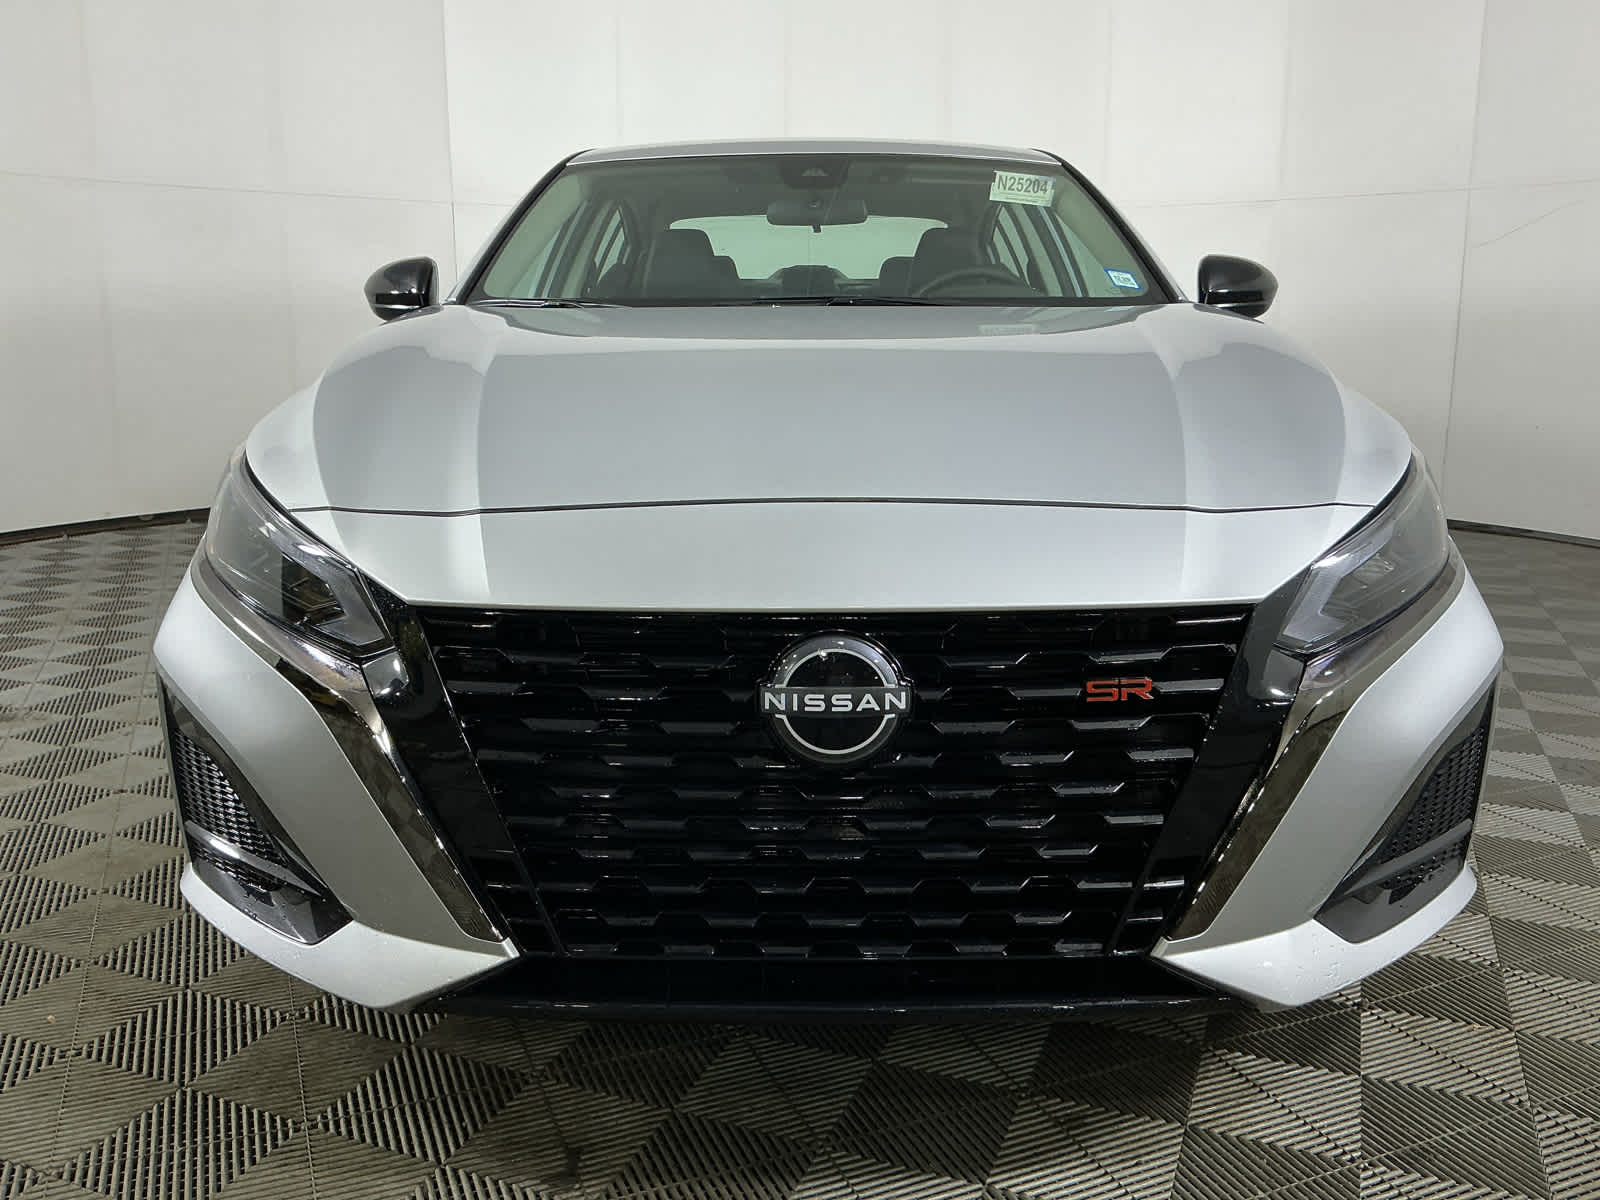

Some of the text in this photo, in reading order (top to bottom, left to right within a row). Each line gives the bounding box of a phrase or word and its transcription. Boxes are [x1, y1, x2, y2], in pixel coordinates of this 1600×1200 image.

[997, 175, 1049, 194] N25204
[1086, 677, 1154, 702] SR
[764, 691, 906, 712] NISSAN
